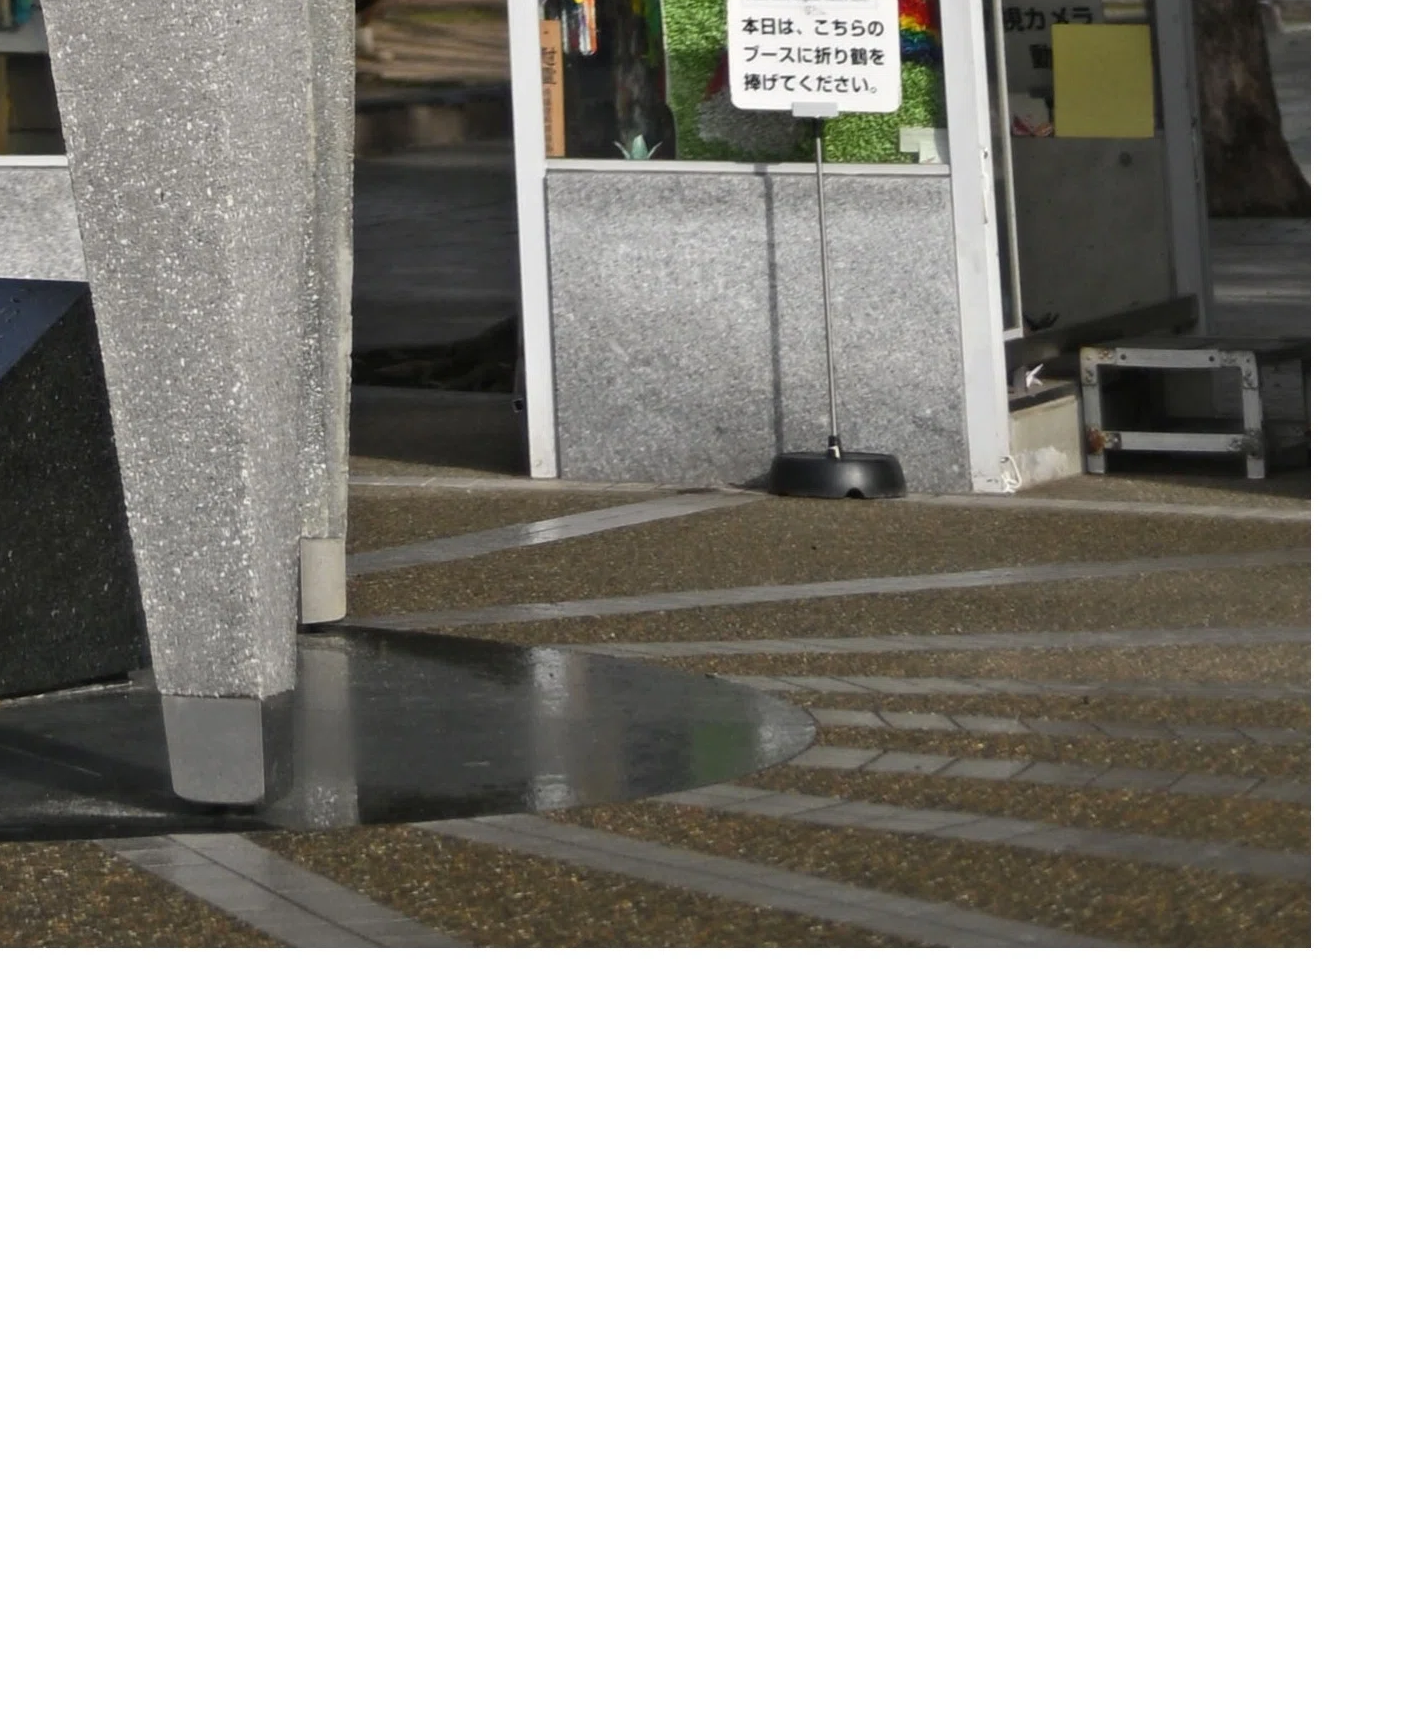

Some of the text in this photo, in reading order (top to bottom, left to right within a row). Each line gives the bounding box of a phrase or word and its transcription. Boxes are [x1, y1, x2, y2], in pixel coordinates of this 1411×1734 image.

[741, 16, 884, 37] 本日は、こちらの
[743, 45, 885, 66] ブースに折り鶴を
[743, 73, 878, 94] 捧げてください。
